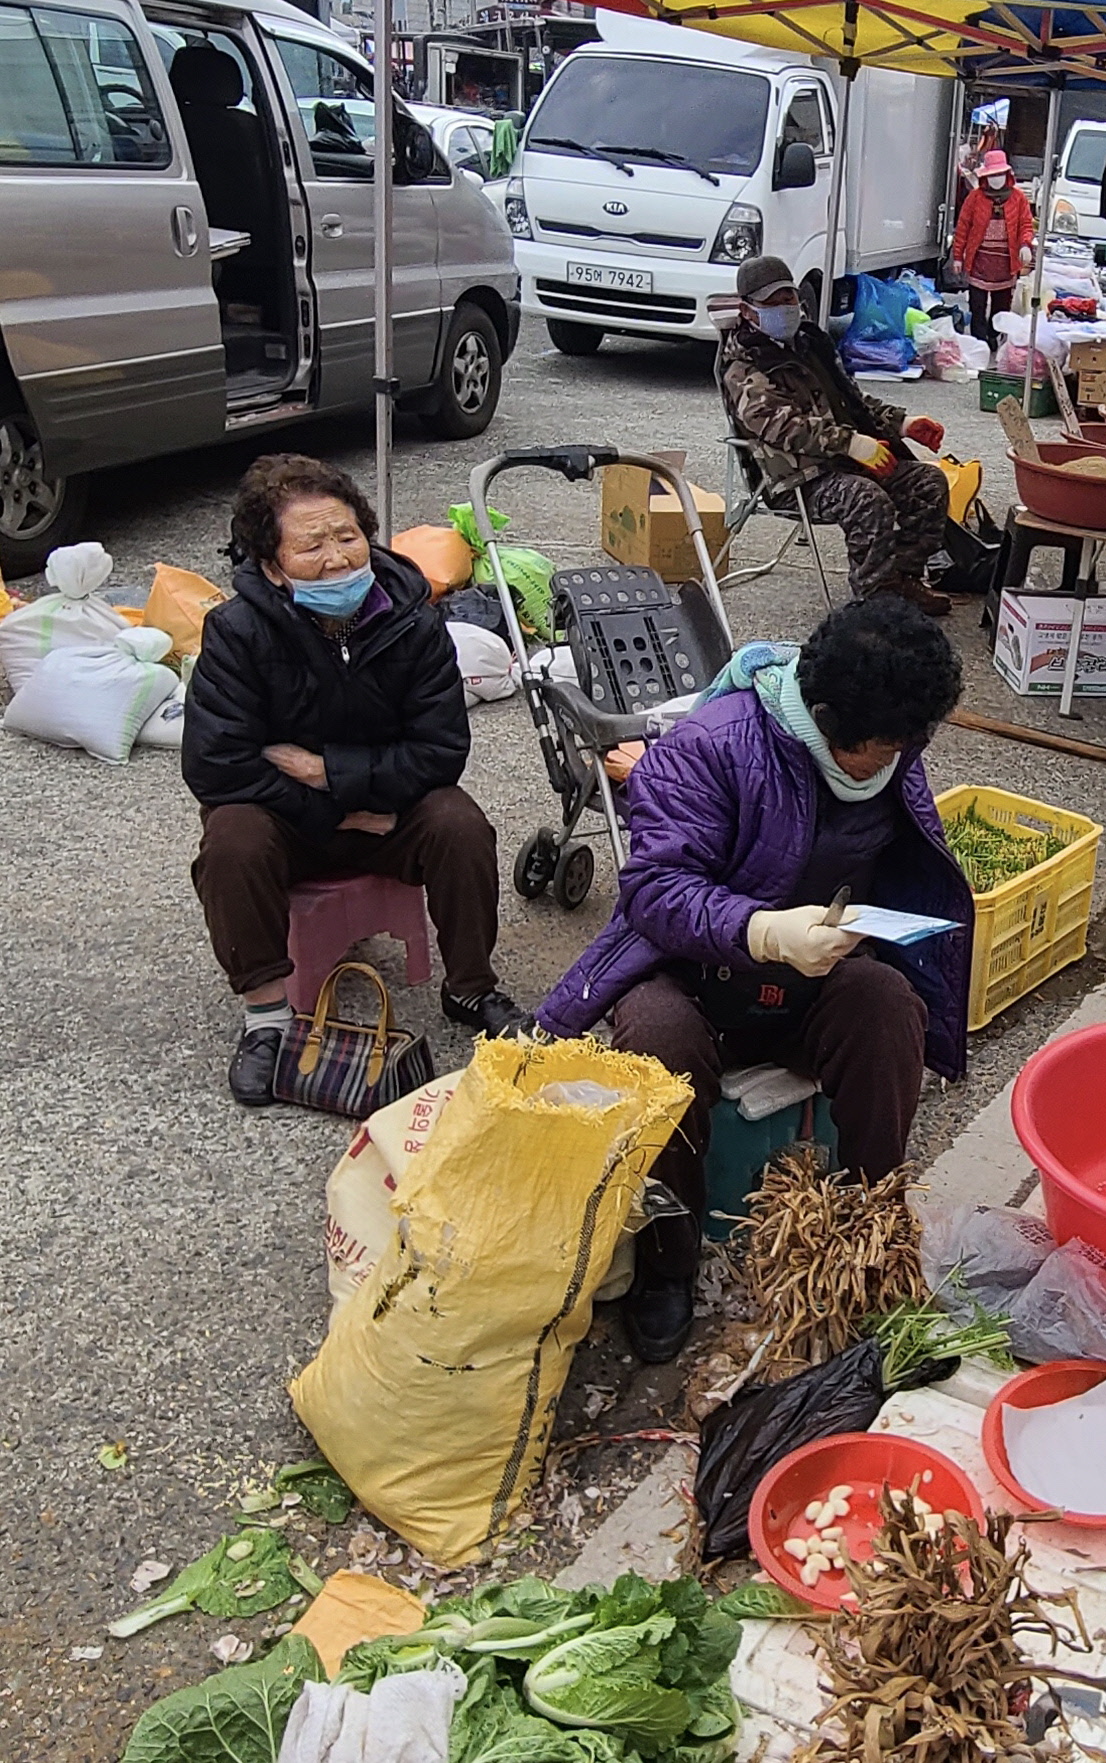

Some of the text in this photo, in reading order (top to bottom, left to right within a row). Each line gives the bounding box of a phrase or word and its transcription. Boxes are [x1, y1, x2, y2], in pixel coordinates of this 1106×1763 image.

[606, 203, 625, 213] KIA
[575, 266, 644, 289] 95어 7942
[408, 1087, 441, 1133] 기술의
